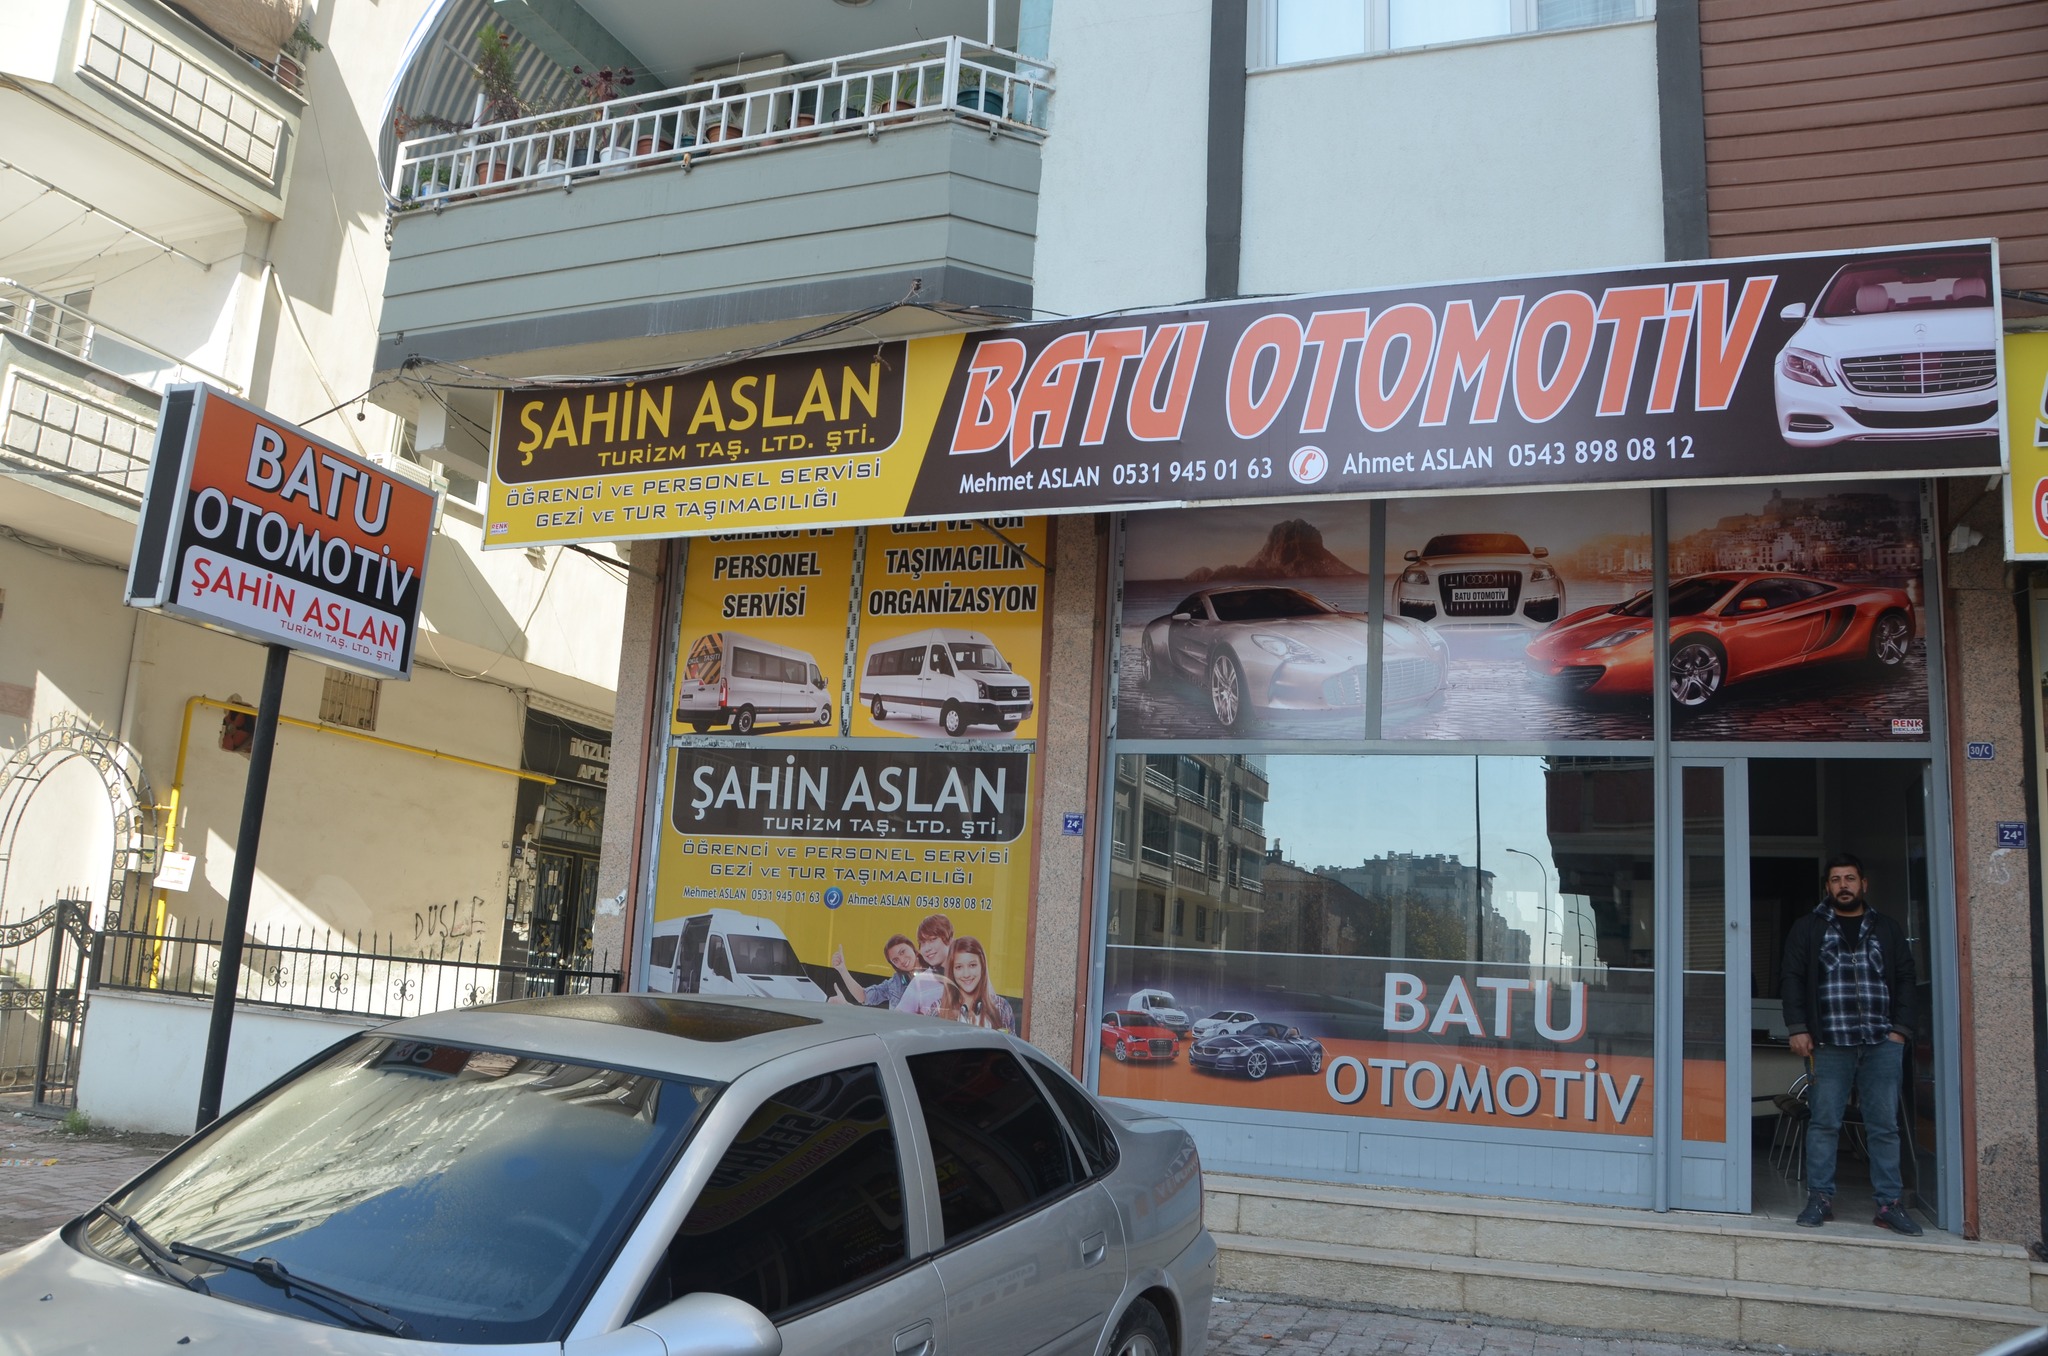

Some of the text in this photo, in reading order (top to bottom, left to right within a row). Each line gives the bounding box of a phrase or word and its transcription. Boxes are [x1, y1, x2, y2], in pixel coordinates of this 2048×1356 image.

[949, 275, 1779, 468] BATU OTOMOTİV
[518, 362, 881, 467] ŞAHİN ASLAN
[598, 424, 876, 467] TURİZM TAŞ. LTD. ŞTİ.
[1342, 435, 1695, 475] Ahmet ASLAN 0543 898 08 12
[246, 423, 393, 537] BATU
[506, 480, 603, 508] ÖĞRENCİ
[642, 472, 770, 496] PERSONEL
[780, 457, 882, 485] SERVİSİ
[959, 457, 1272, 494] Mehmet ASLAN 0531 945 01 63
[535, 507, 584, 529] GEZİ
[622, 504, 666, 522] TUR
[675, 488, 838, 521] TAŞIMACILIĞI
[194, 486, 414, 606] OTOMOTİV
[713, 552, 821, 580] PERSONEL
[885, 544, 1026, 579] TAŞIMACILIK
[191, 557, 398, 651] ŞAHİN ASLAN
[722, 586, 807, 619] SERVİSİ
[868, 581, 1038, 617] ORGANİZASYON
[1455, 591, 1471, 600] BATU
[281, 620, 394, 662] TURİZM TAŞ. LTD. ŞTİ.
[1970, 745, 1990, 757] 30/C
[691, 754, 1006, 820] ŞAHİN ASLAN
[763, 814, 1002, 839] TURİZM TAŞ. LTD. ŞTİ.
[683, 839, 769, 857] ÖĞRENCİ
[804, 847, 915, 861] PERSONEL
[923, 847, 1009, 864] SERVİSİ
[710, 861, 753, 877] GEZİ
[788, 866, 827, 880] TUR
[834, 867, 973, 888] TAŞIMACILIĞI
[683, 887, 992, 910] Mehmet ASLAN 0531 945 01 63 Ahmet ASLAN 0543 898 08 12
[1382, 972, 1587, 1043] BATU
[1325, 1056, 1642, 1124] OTOMOTİV
